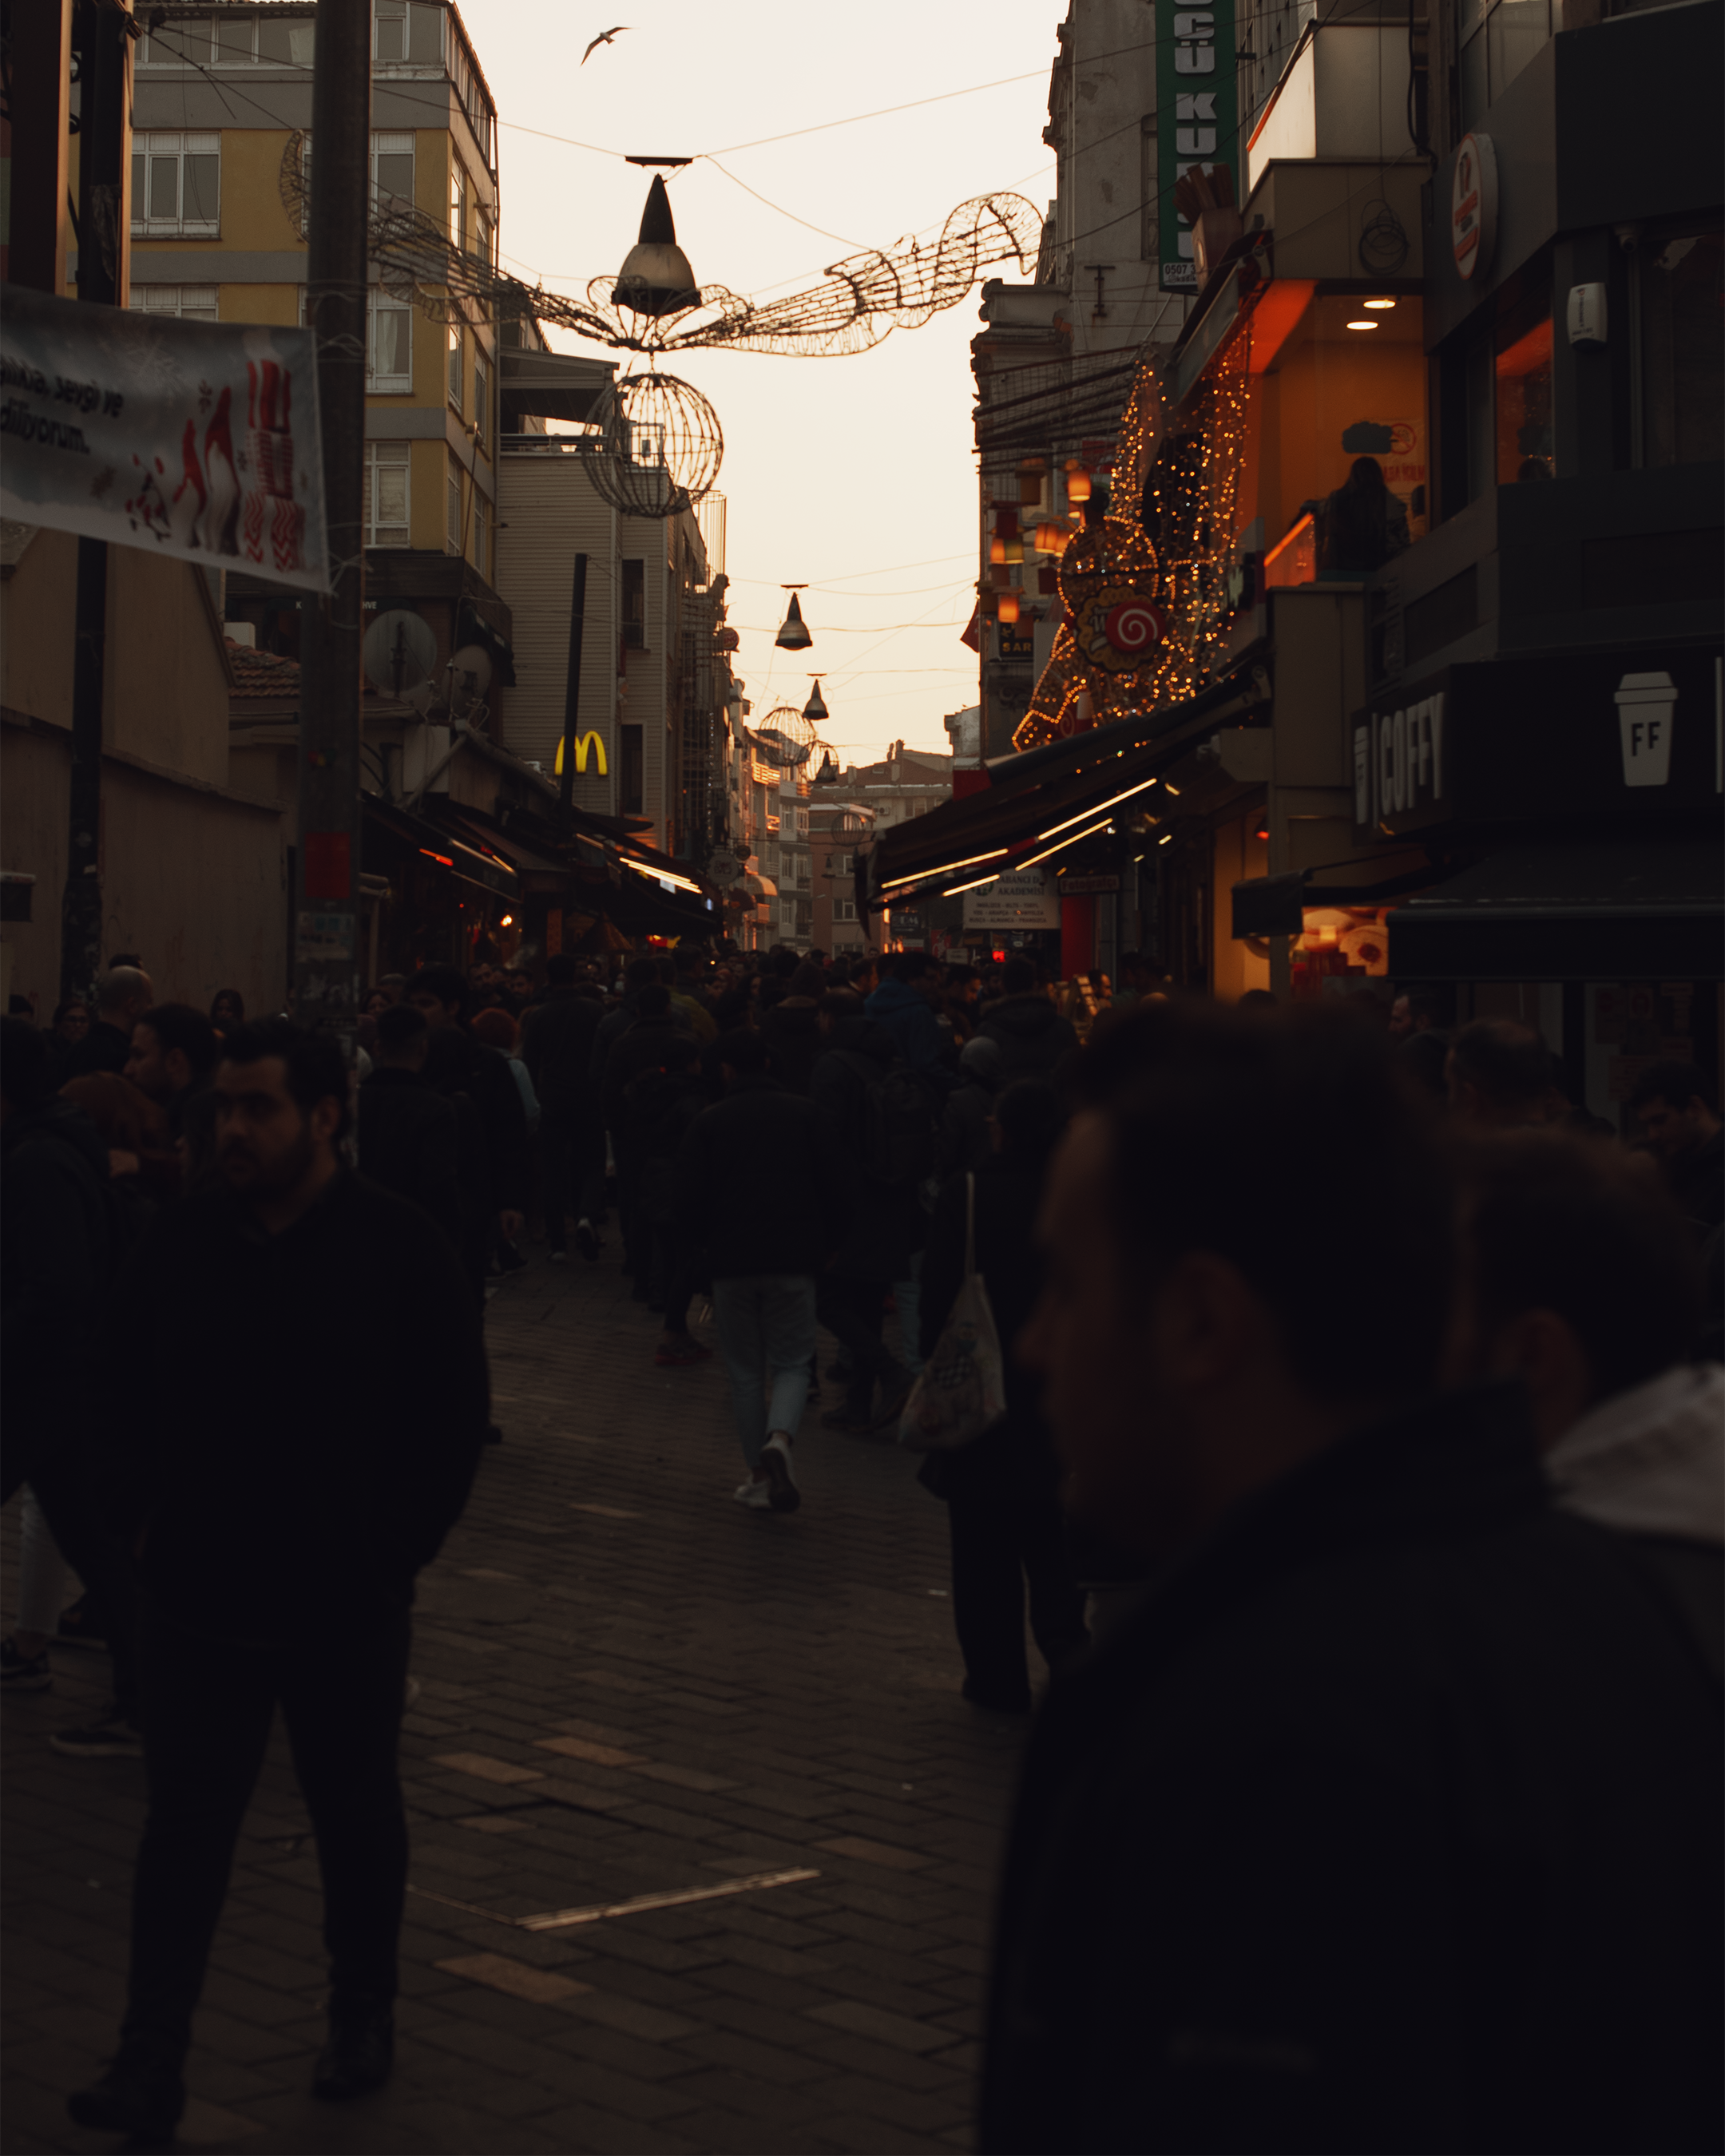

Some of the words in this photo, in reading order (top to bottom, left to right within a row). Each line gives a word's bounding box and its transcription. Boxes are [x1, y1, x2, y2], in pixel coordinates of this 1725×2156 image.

[1165, 264, 1187, 275] 0507
[54, 375, 100, 413] sevgi
[102, 390, 124, 418] ve
